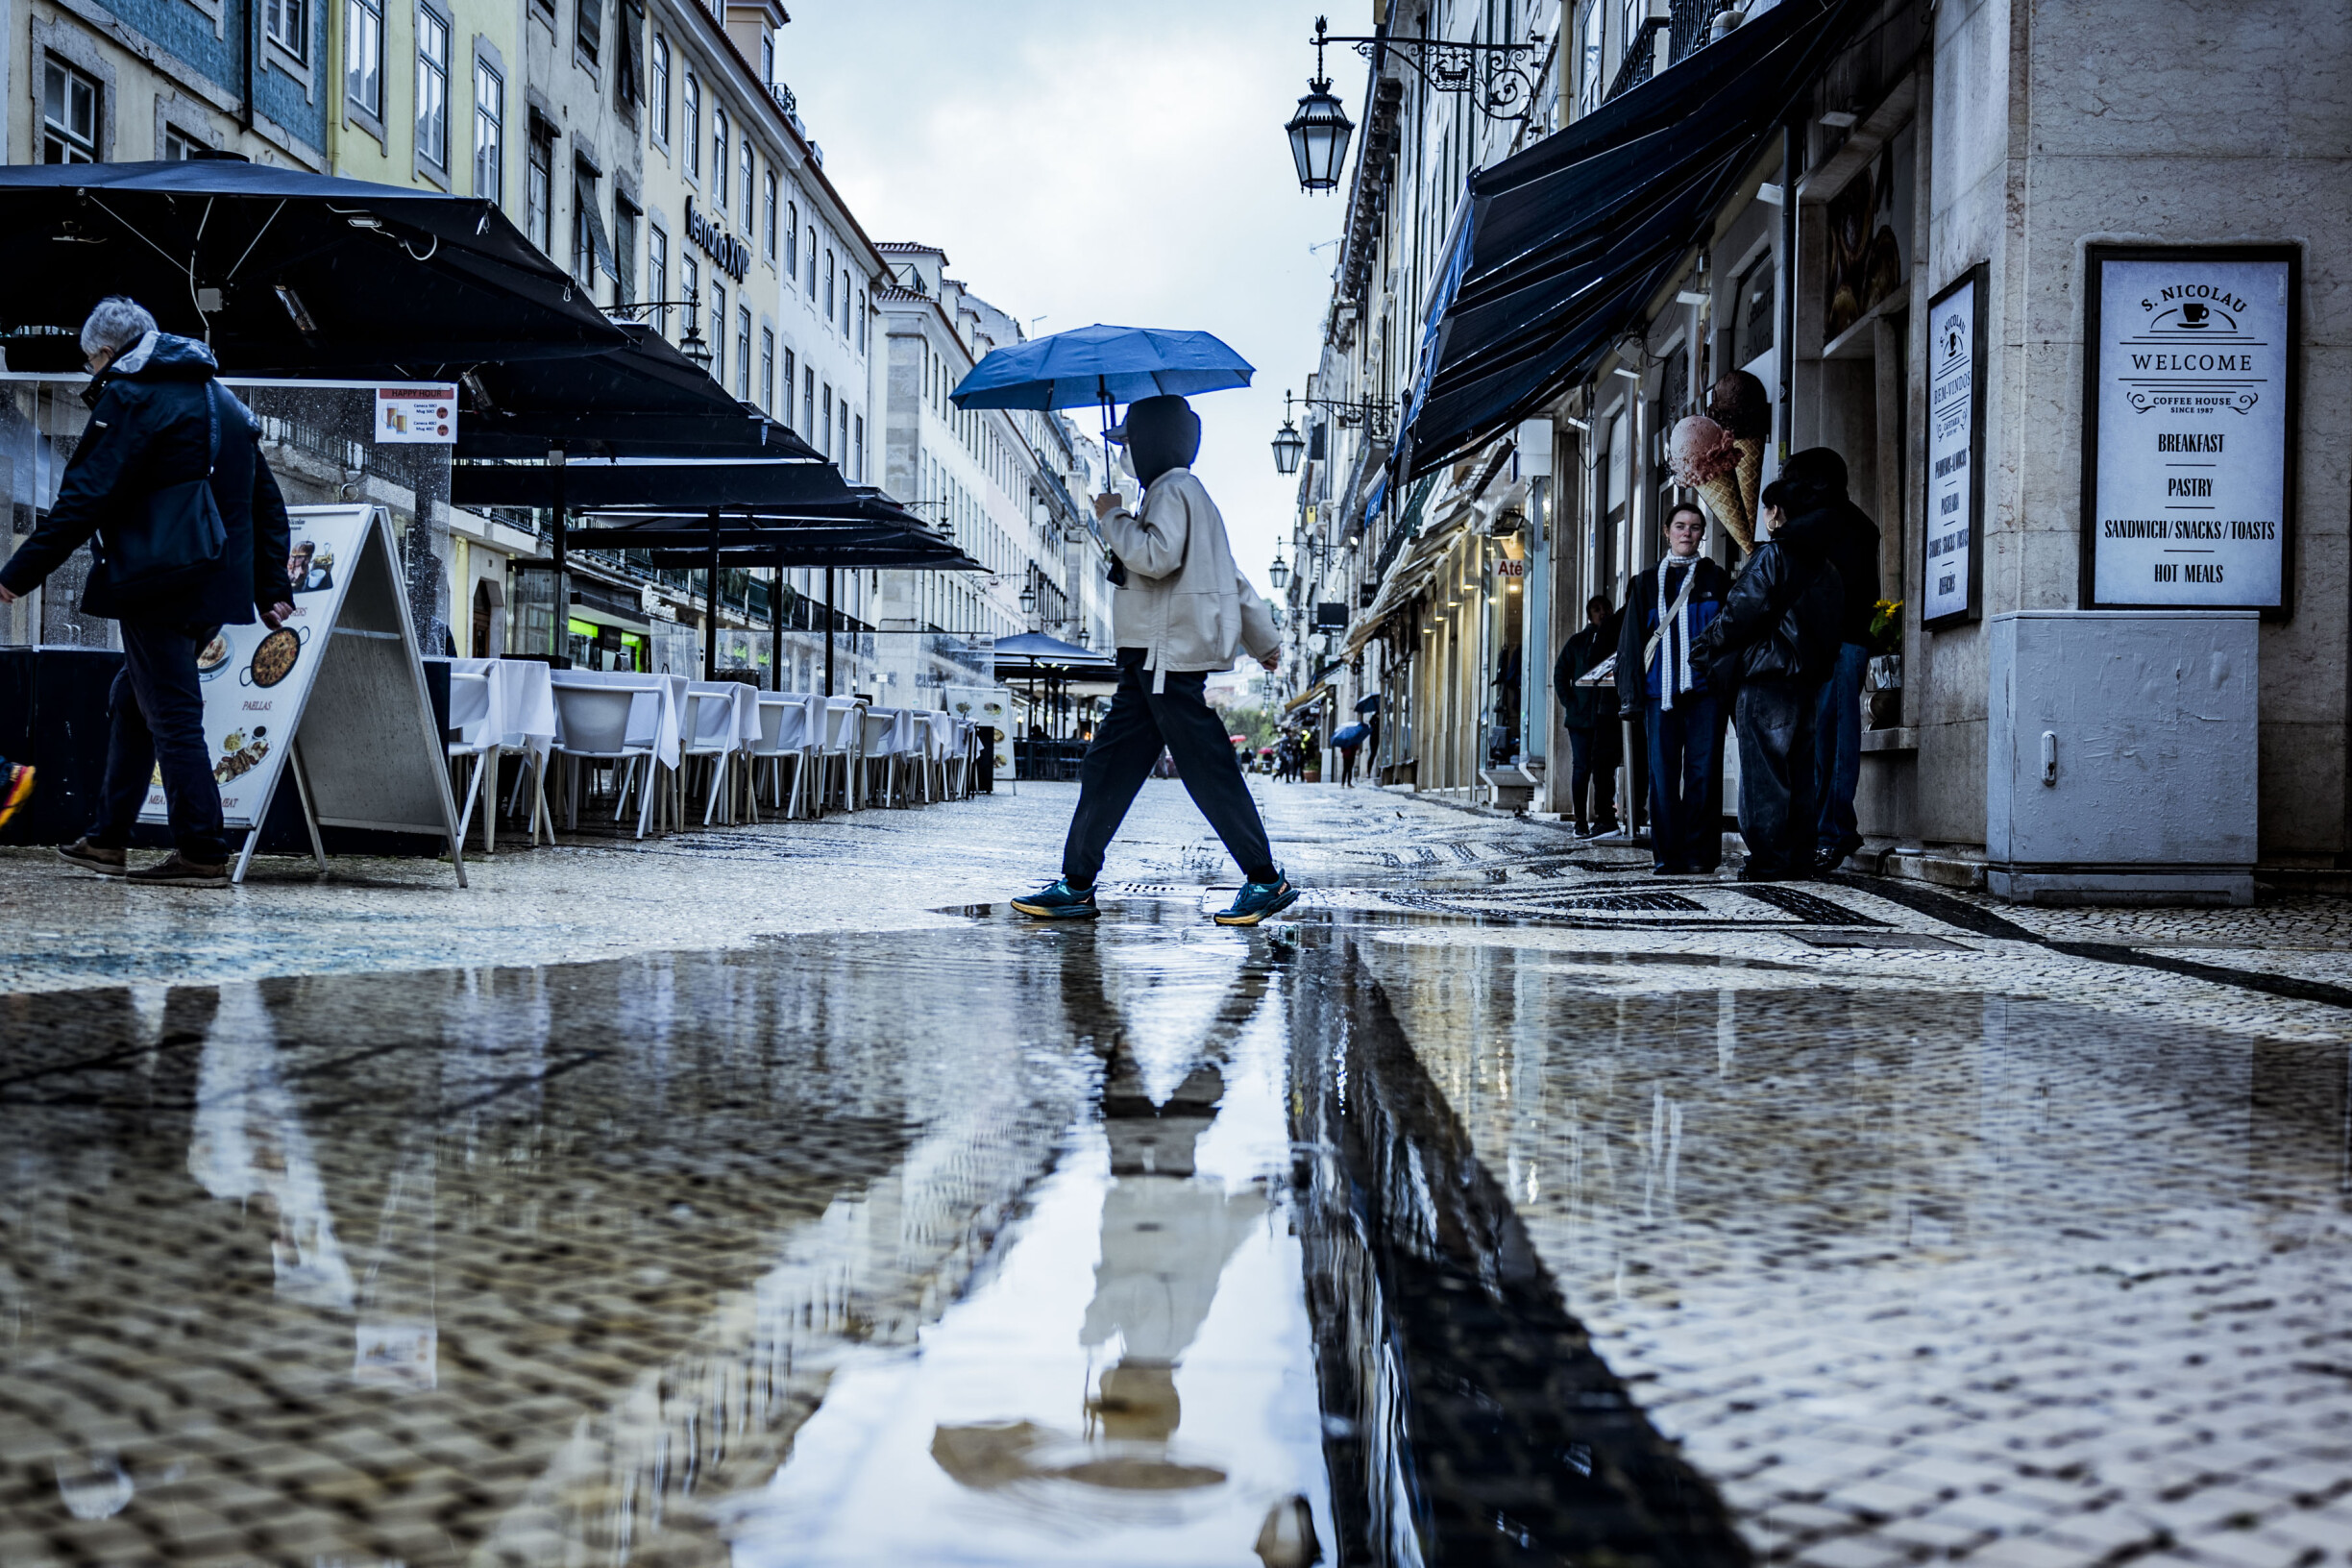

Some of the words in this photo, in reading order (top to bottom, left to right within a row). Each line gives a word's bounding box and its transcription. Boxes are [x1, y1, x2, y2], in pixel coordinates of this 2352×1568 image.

[2141, 298, 2158, 312] S.
[2161, 284, 2247, 313] NICOLAU
[1944, 313, 1966, 335] NICOLAU
[2131, 354, 2252, 371] WELCOME
[1934, 370, 1971, 404] BEM-VINDOS
[2153, 397, 2193, 405] COFFEE
[2195, 397, 2231, 405] HOUSE
[2158, 433, 2225, 453] BREAKFAST
[2168, 478, 2214, 497] PASTRY
[1498, 560, 1524, 576] Até
[2154, 564, 2178, 582] HOT
[2184, 564, 2224, 583] MEALS
[242, 700, 272, 711] PAELLAS
